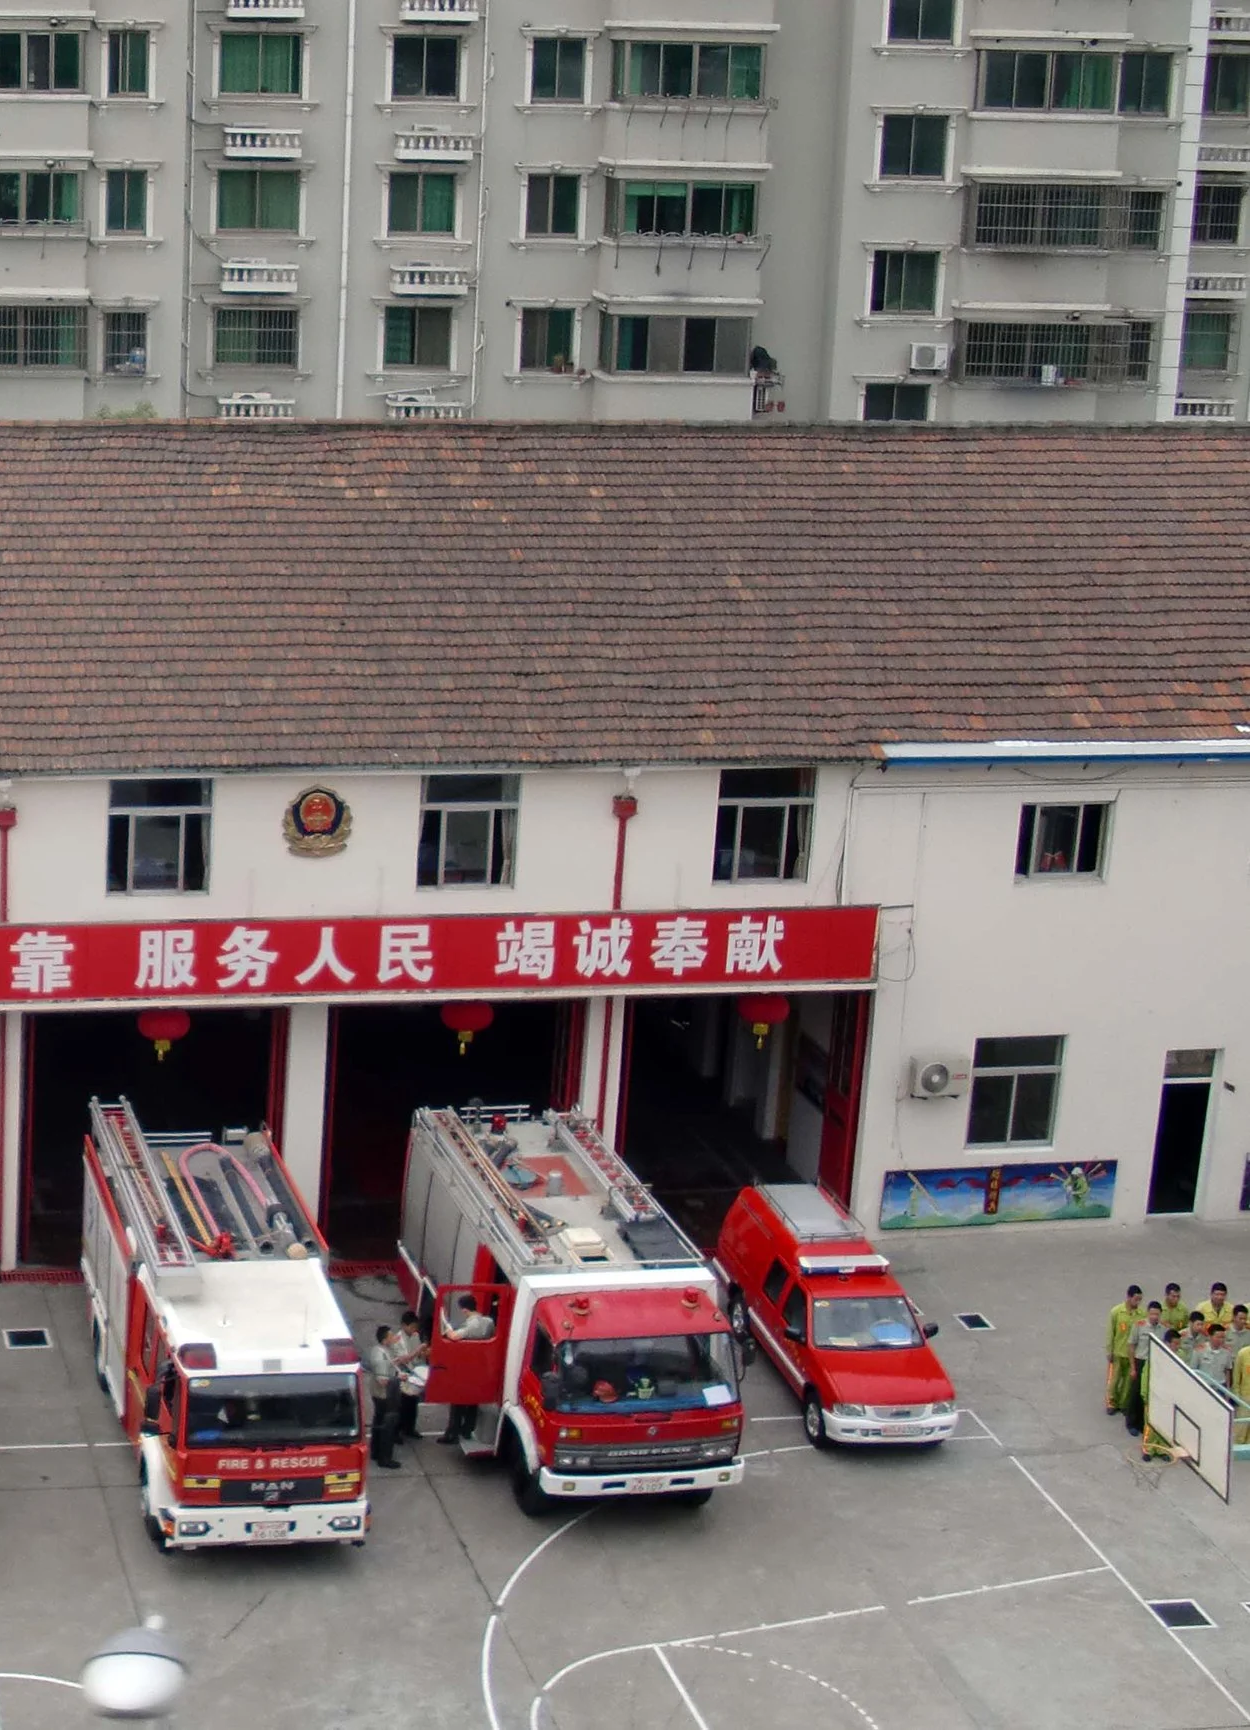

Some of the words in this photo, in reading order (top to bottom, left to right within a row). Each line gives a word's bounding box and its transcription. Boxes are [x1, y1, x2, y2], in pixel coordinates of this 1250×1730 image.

[135, 925, 434, 989] 服务人民
[494, 914, 785, 980] 竭诚奉献
[217, 1459, 249, 1469] FIRE
[255, 1459, 265, 1469] &
[270, 1456, 327, 1467] RESCUE
[251, 1481, 295, 1491] MAN
